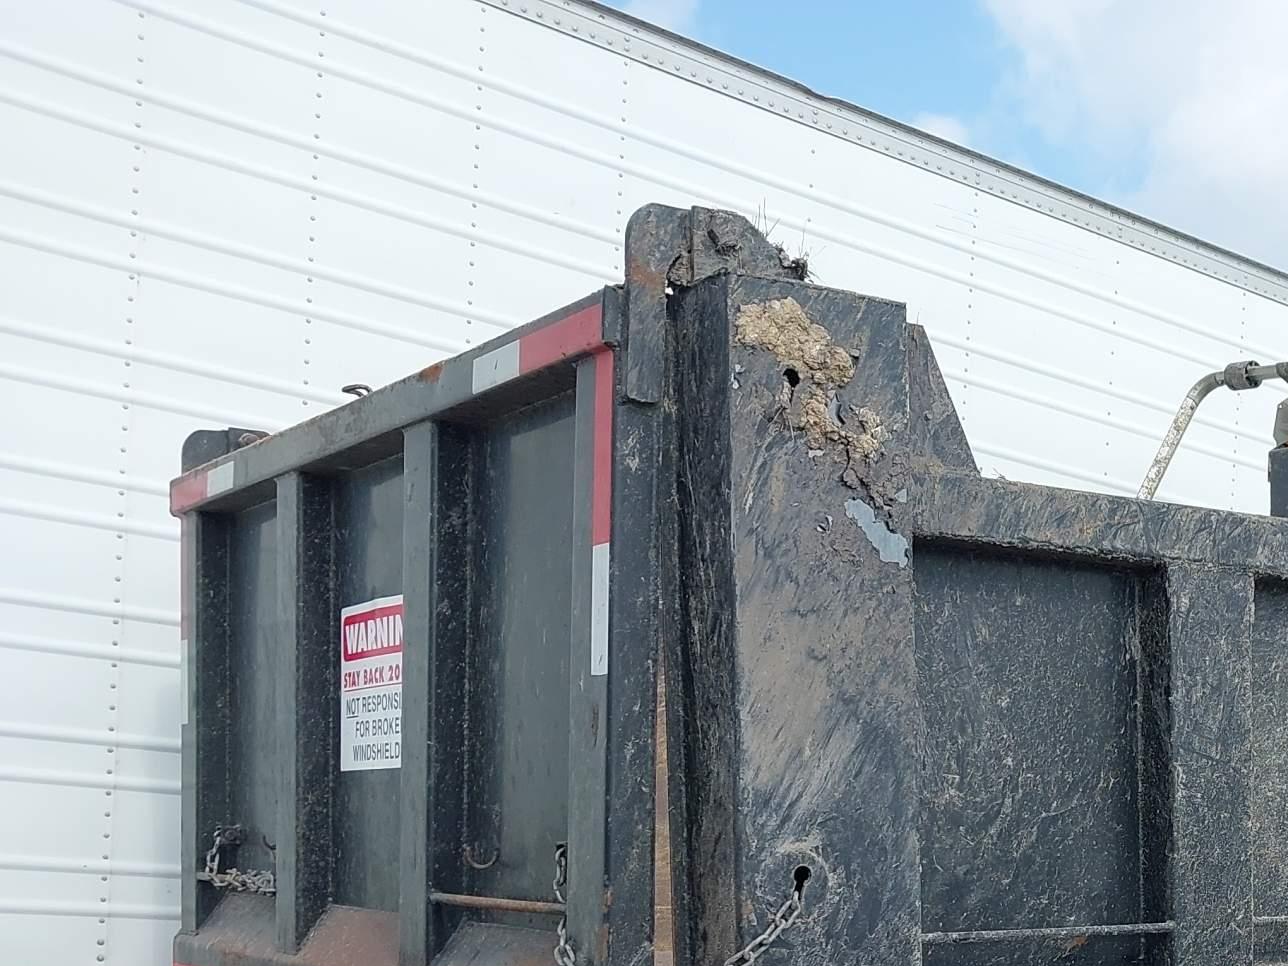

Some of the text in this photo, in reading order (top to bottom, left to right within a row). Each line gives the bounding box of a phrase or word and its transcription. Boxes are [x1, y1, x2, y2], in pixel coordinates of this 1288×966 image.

[344, 670, 361, 689] STAY
[364, 667, 385, 686] BACK
[346, 697, 361, 716] NOT
[355, 717, 400, 739] FOR BROKE
[352, 742, 401, 762] WINDSHIELD
